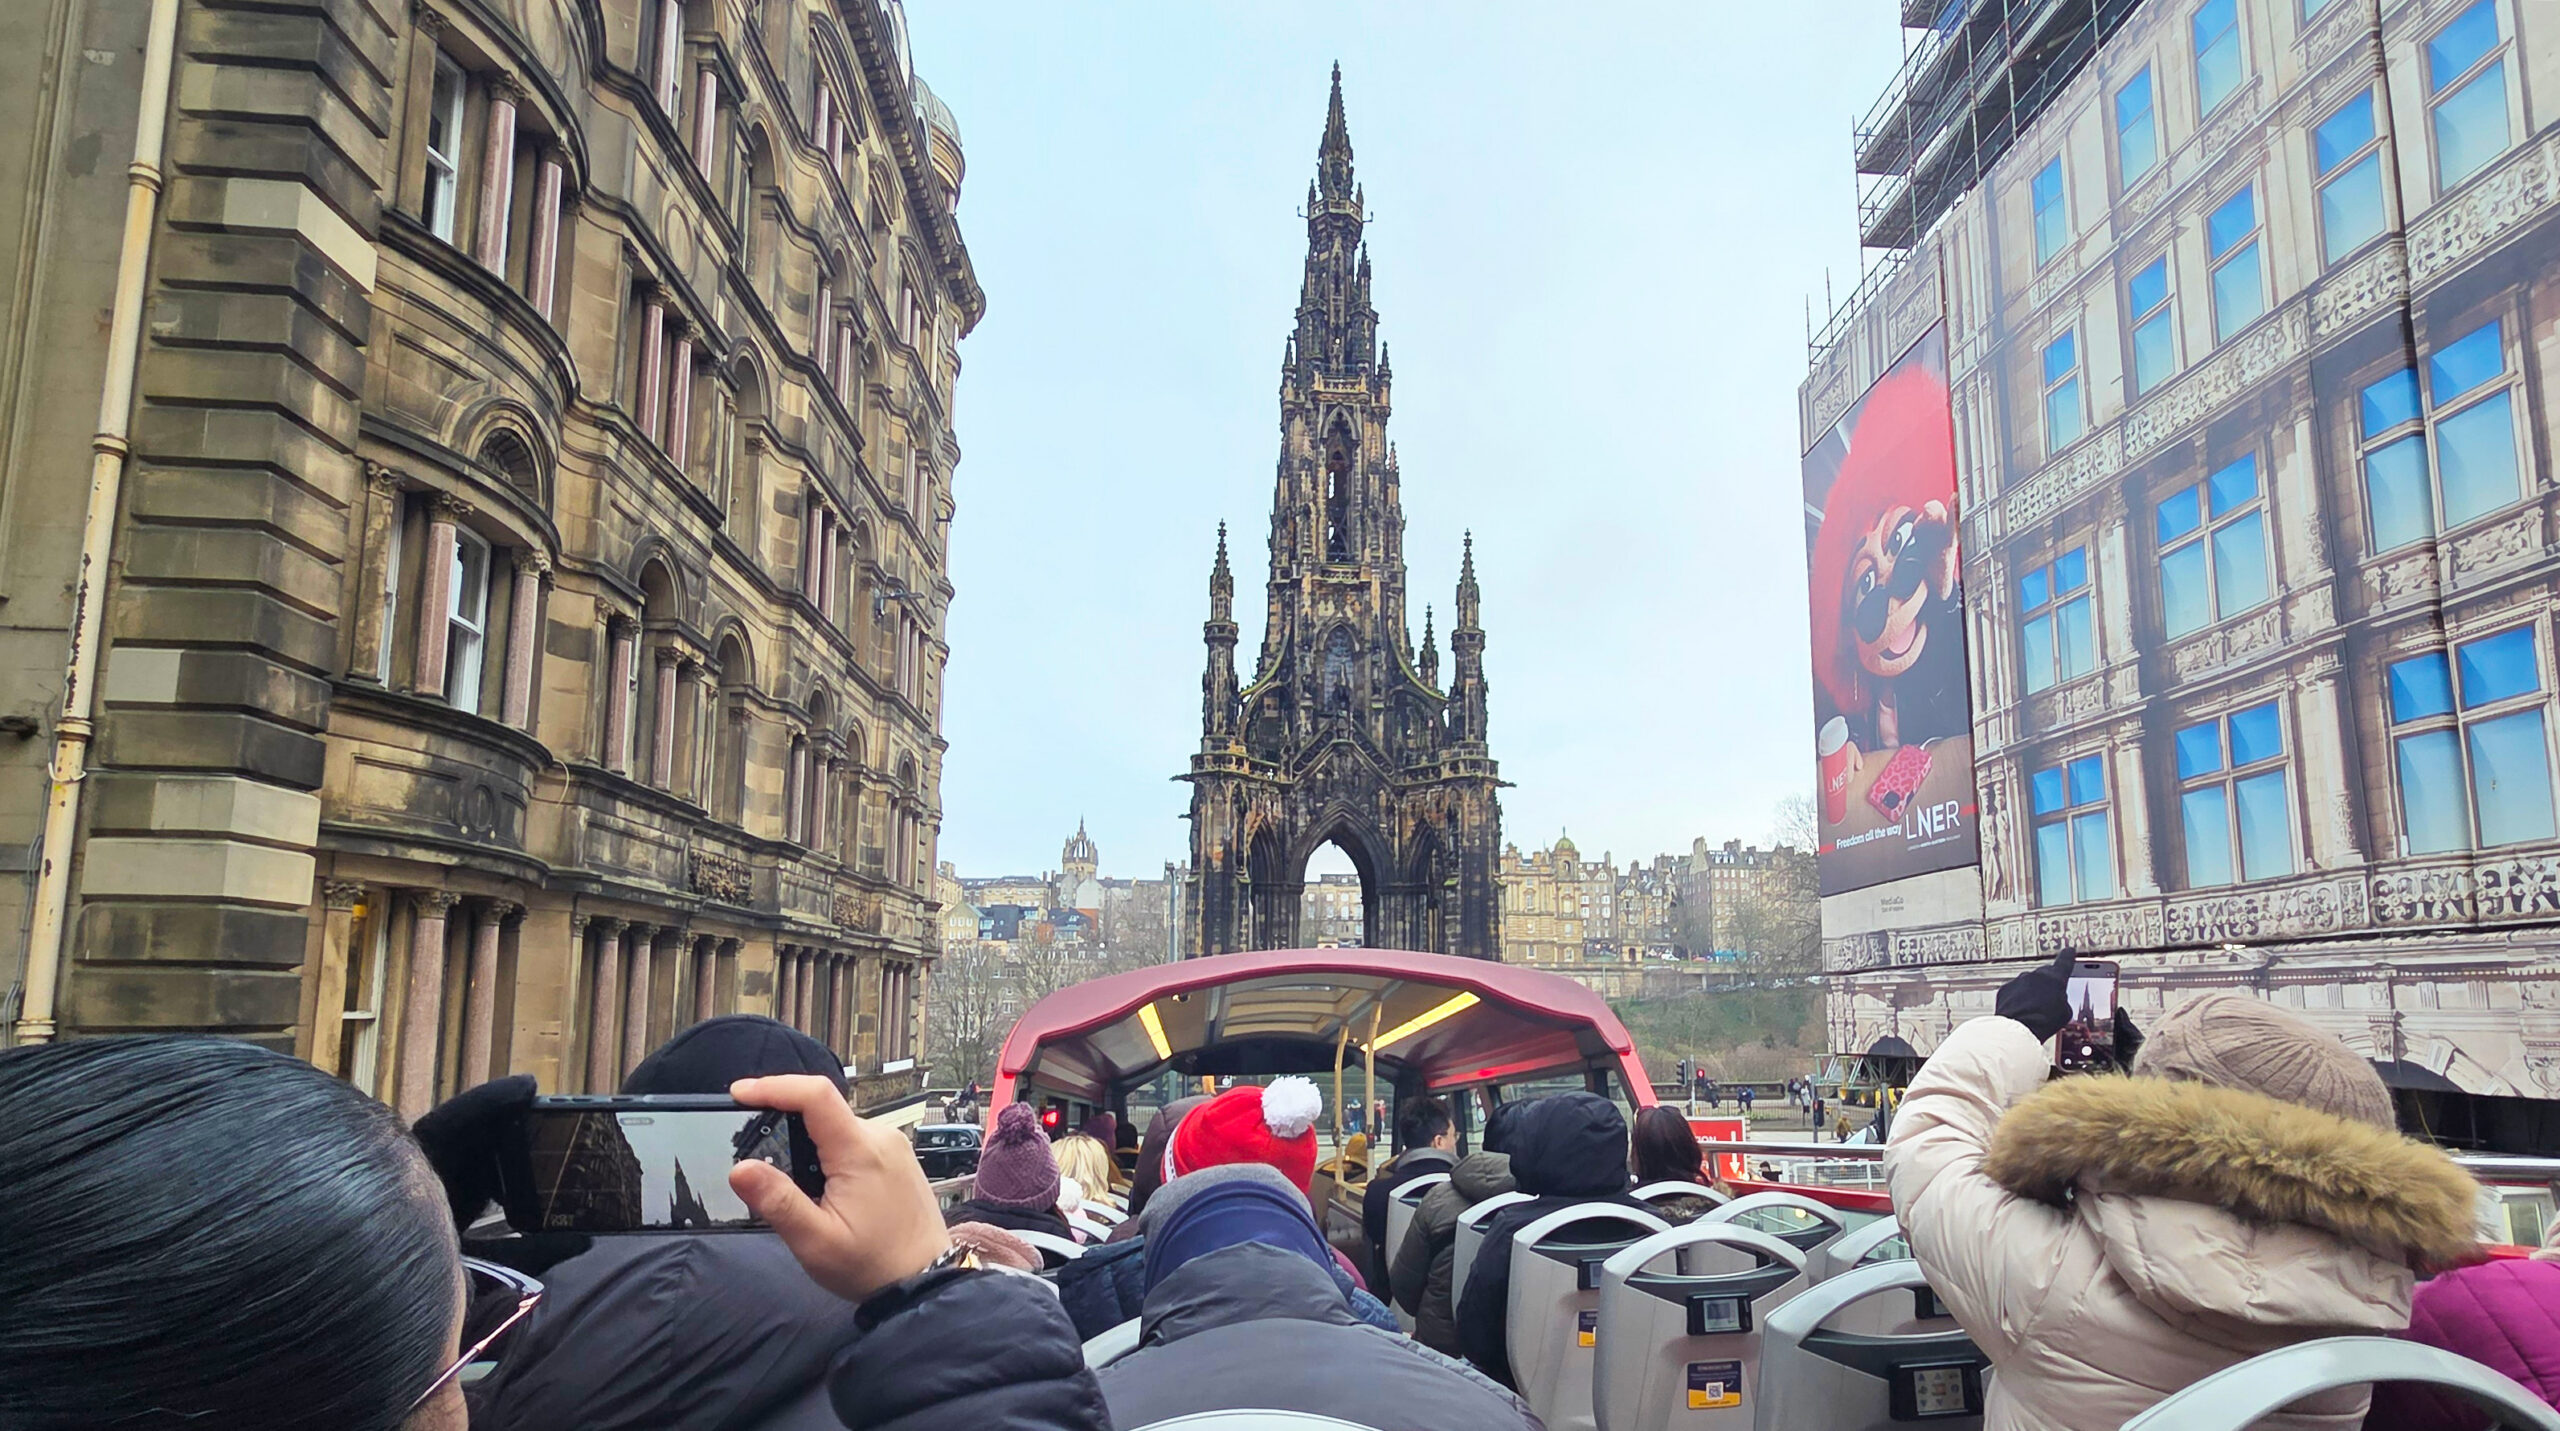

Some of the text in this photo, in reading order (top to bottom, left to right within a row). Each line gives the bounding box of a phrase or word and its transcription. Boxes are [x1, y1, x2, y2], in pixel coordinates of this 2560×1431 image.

[1905, 800, 1960, 839] LNER
[1836, 823, 1902, 850] Freedom all the way
